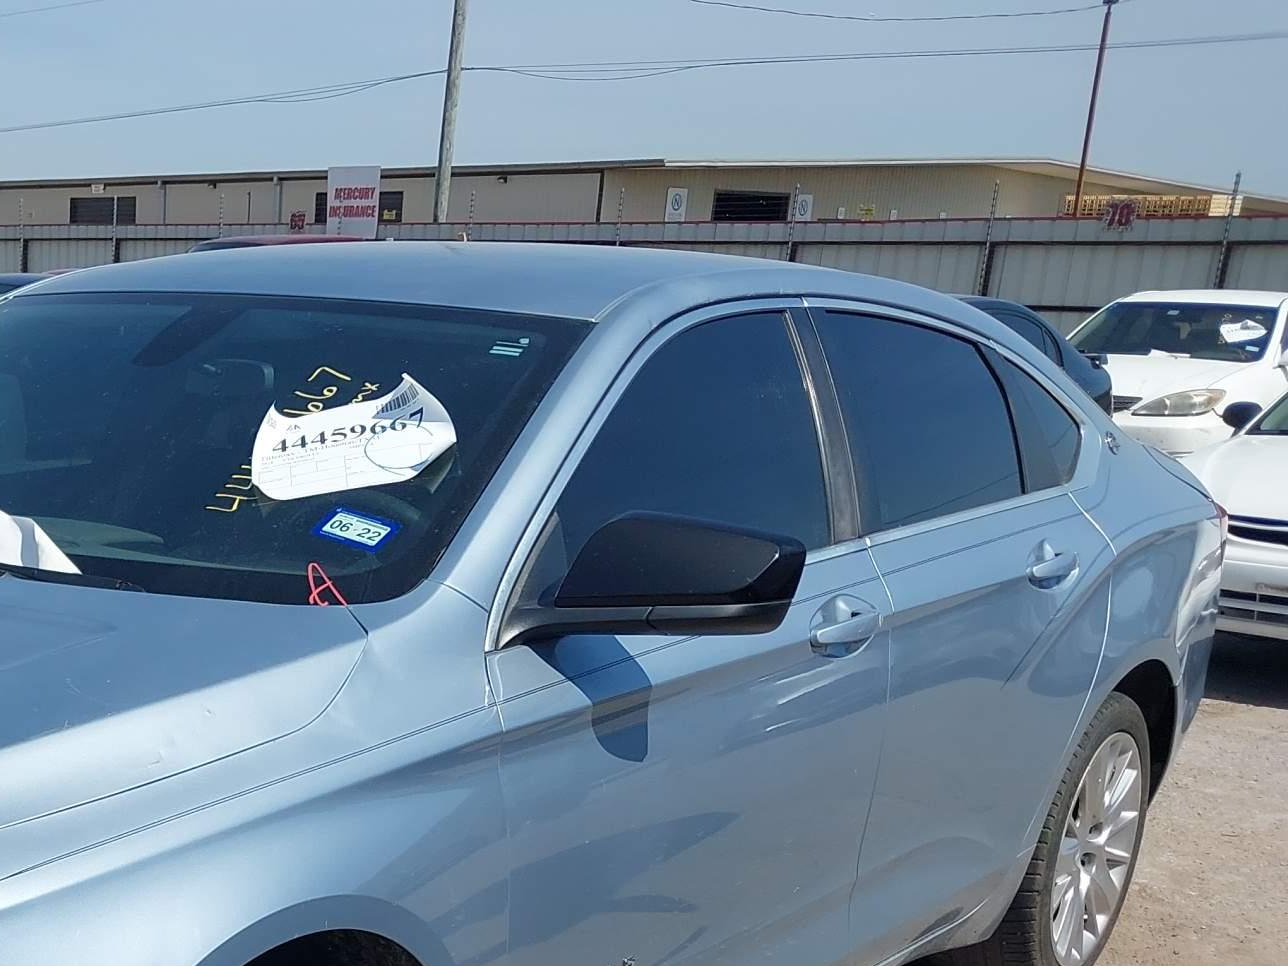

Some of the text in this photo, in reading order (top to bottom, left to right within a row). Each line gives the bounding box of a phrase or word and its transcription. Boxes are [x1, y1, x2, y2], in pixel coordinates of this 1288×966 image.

[334, 187, 376, 201] MERCURY
[328, 205, 377, 218] INSURANCE
[271, 406, 424, 454] 44459667
[329, 519, 354, 533] 06
[356, 527, 382, 542] 22
[306, 561, 349, 607] A
